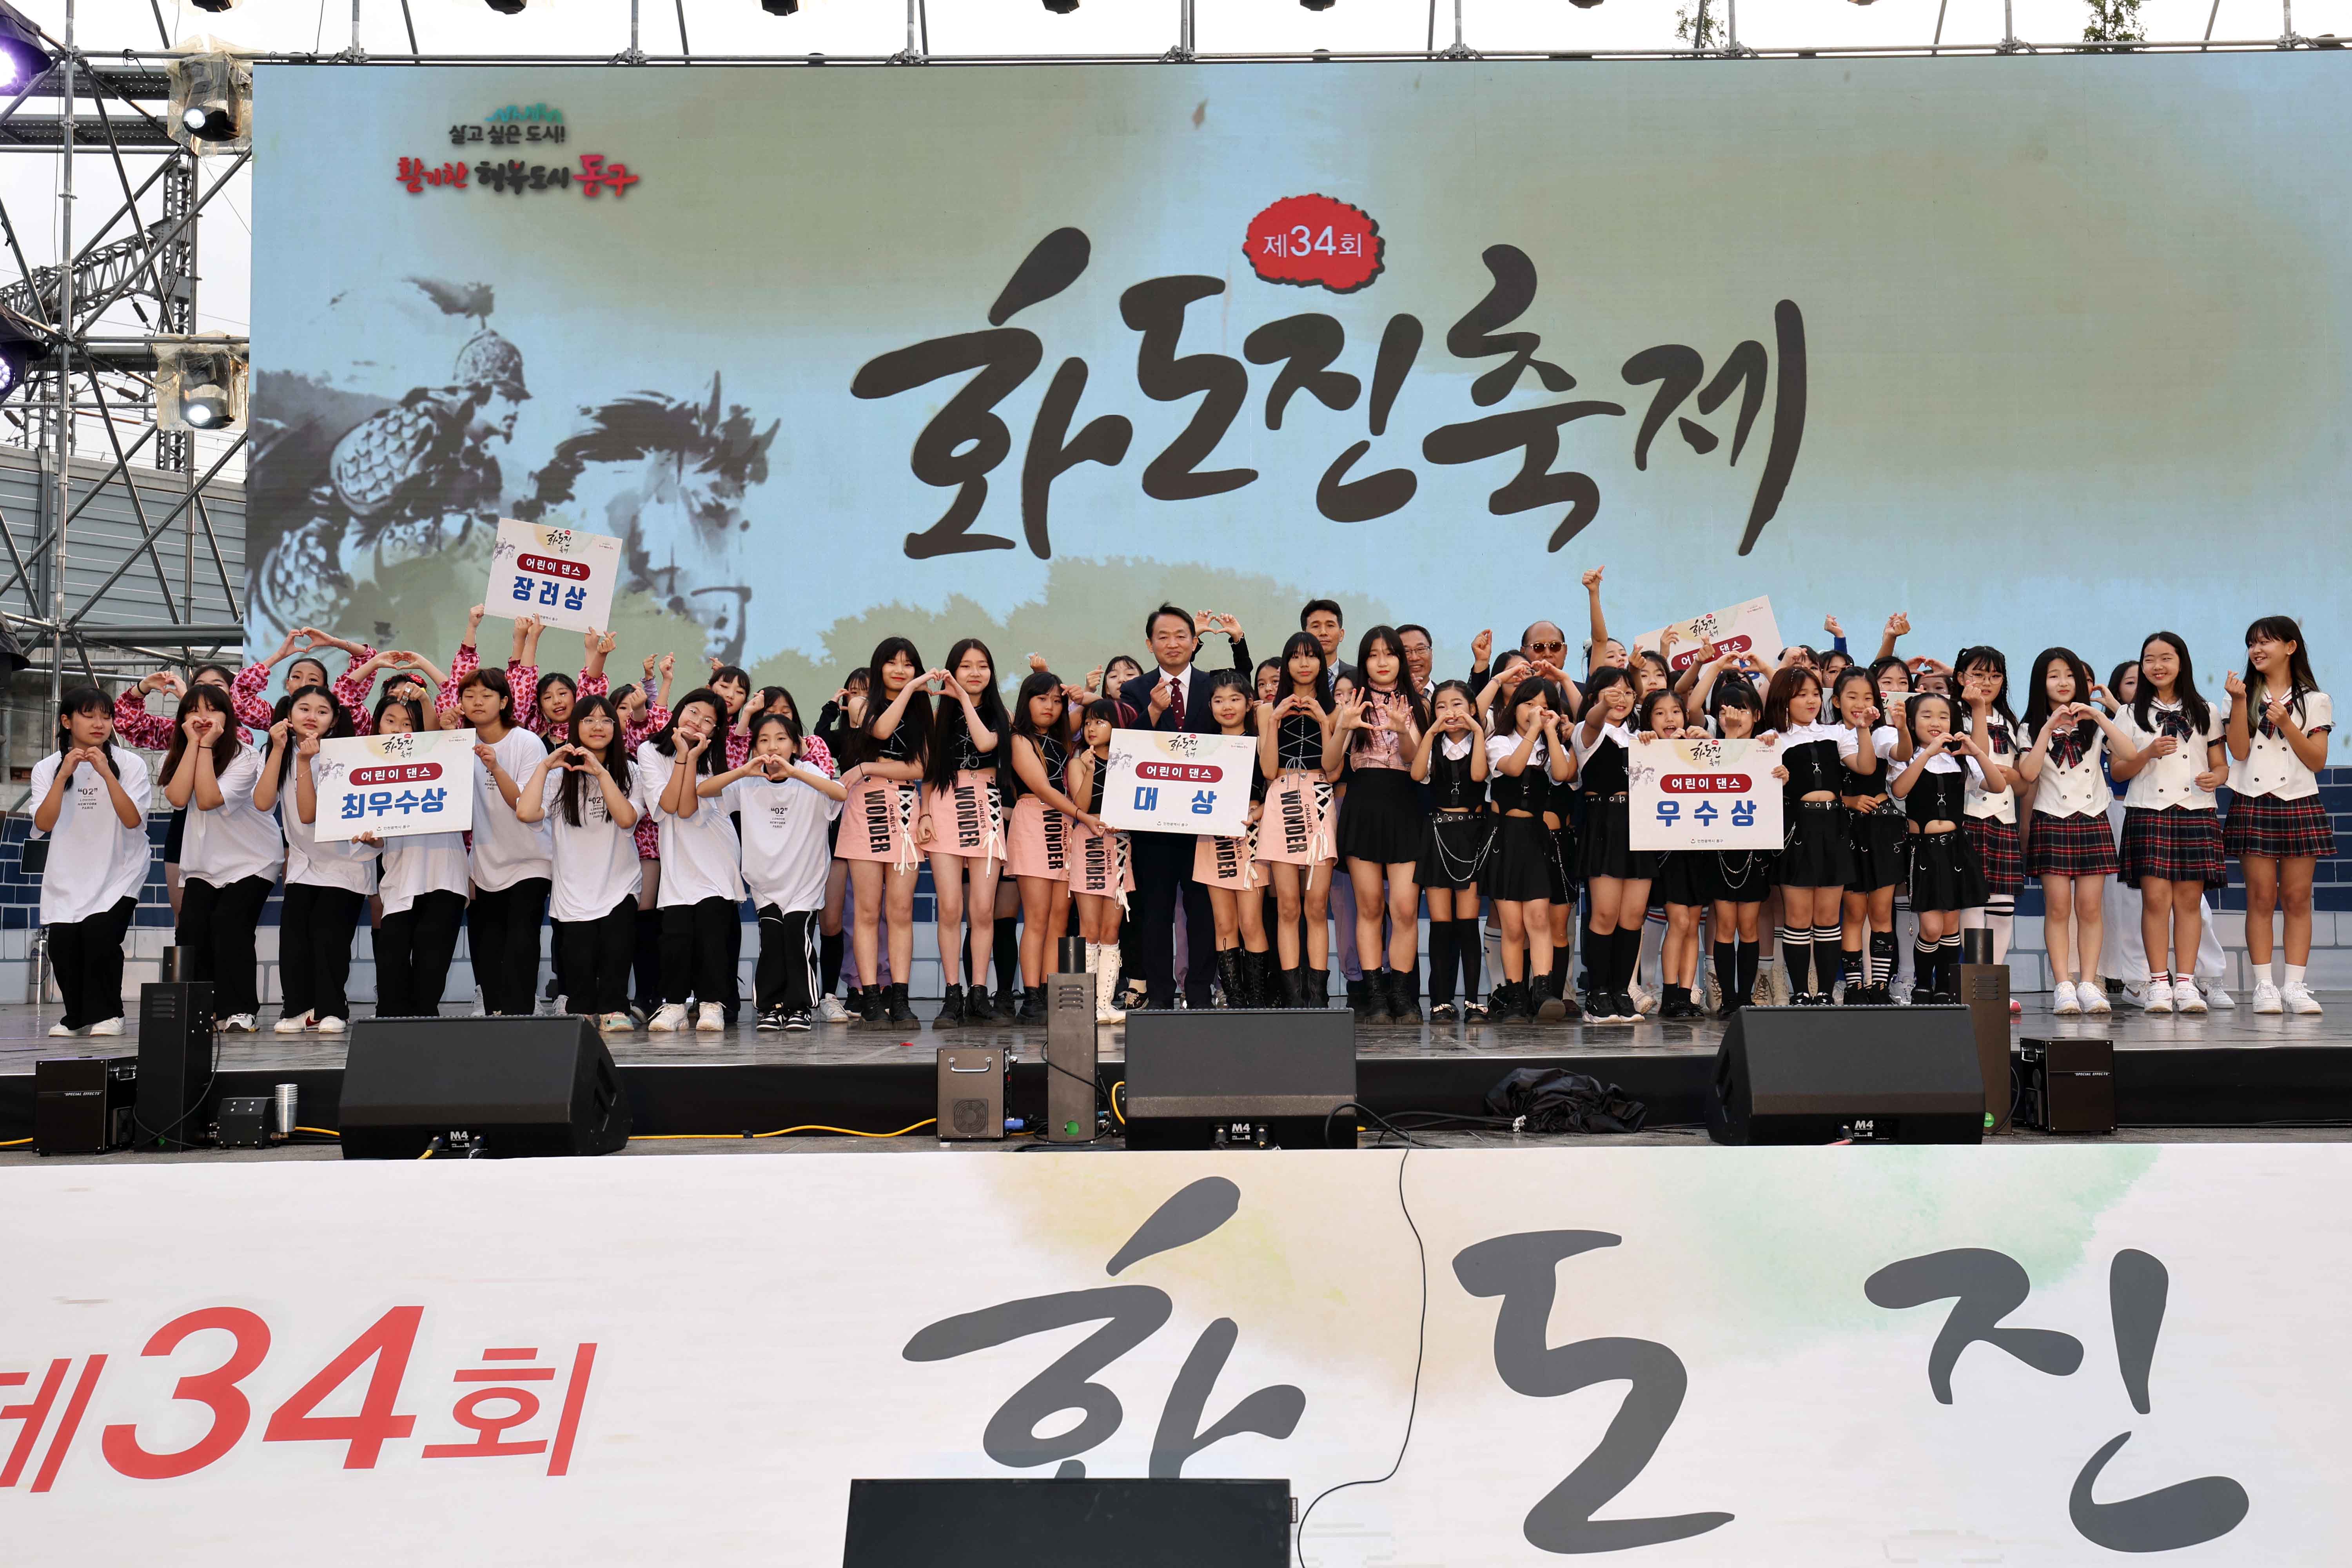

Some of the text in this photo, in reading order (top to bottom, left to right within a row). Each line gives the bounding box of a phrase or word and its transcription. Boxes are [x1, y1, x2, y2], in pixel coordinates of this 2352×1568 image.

[449, 125, 565, 144] 살고 싶은 도시!
[396, 155, 639, 197] 활기찬 행복도시 동구
[1263, 225, 1361, 258] 제34회
[850, 226, 1807, 557] 화도진축제
[546, 530, 572, 546] 화도진
[526, 558, 581, 576] 어린이 댄스
[513, 576, 587, 611] 장려상
[1690, 619, 1717, 637] 화도진
[1719, 641, 1742, 655] 댄스
[382, 736, 414, 753] 화도진
[1168, 735, 1198, 751] 화도진
[1690, 742, 1721, 760] 화도진
[361, 767, 431, 782] 어린이 댄스
[1147, 766, 1212, 779] 어린이 댄스
[1671, 778, 1740, 789] 어린이 댄스
[341, 788, 447, 819] 최우수상
[954, 786, 980, 848] WONDER
[978, 800, 986, 829] CHARLIE'S
[1656, 800, 1756, 827] 우수상
[864, 789, 891, 853] WONDER
[889, 804, 897, 833] CHARLIE'S
[1280, 789, 1308, 854] WONDER
[1305, 804, 1313, 834] CHARLIE'S
[1043, 809, 1063, 869] WONDER
[1085, 837, 1105, 890] WONDER
[1214, 835, 1237, 878] NDER
[450, 1131, 468, 1139] M4
[1232, 1123, 1250, 1132] M4
[0, 1305, 597, 1493] 제34회
